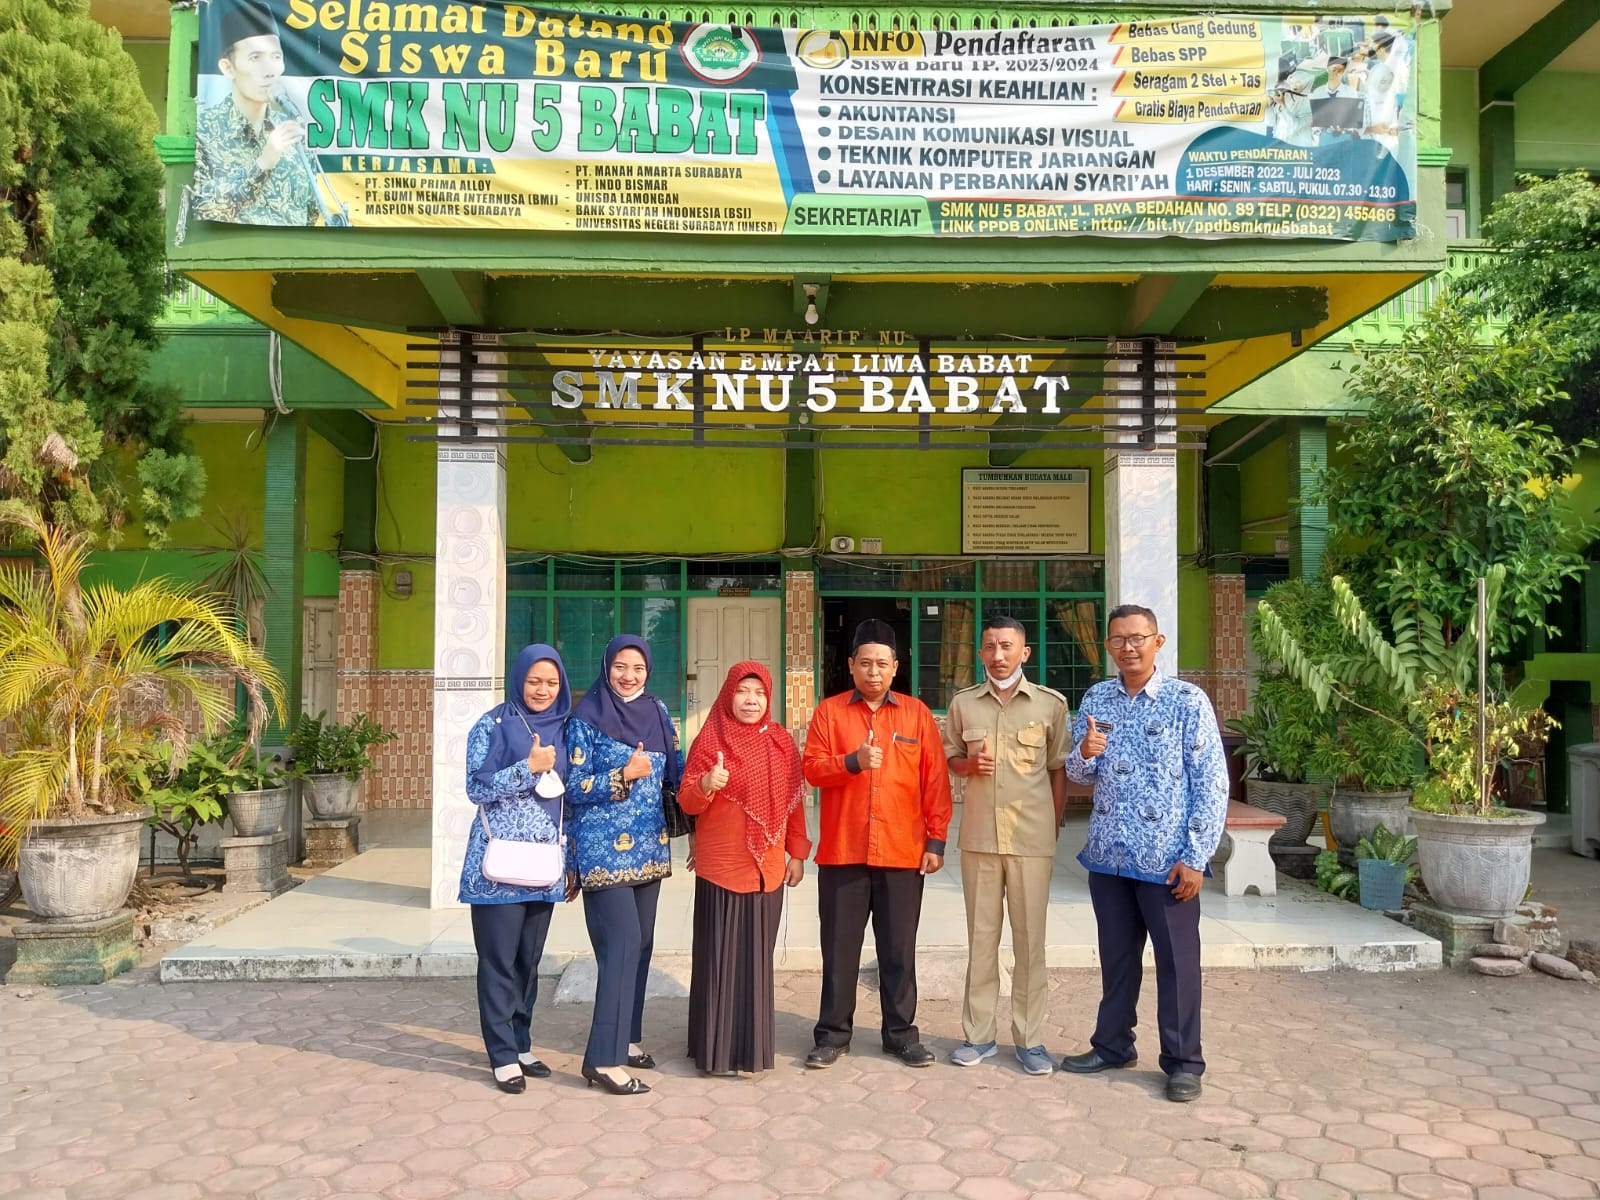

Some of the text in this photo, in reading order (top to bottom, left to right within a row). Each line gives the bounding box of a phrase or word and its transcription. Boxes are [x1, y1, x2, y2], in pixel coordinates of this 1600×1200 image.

[285, 0, 674, 50] Selamat Datang
[1128, 21, 1257, 39] Bebas Uang Gedung
[852, 30, 1096, 56] INFO Pendaftaran
[339, 31, 668, 83] Siswa Baru
[1131, 46, 1208, 63] Bebas SPP
[1007, 58, 1099, 72] 2023/2024
[820, 75, 972, 98] KONSENTRASI
[979, 79, 1086, 101] KEAHLIAN
[1133, 71, 1188, 91] Seragam
[1191, 74, 1199, 88] 2
[1201, 72, 1227, 87] Stel
[1240, 73, 1261, 89] Tas
[307, 79, 765, 155] SMK NU 5 BABAT
[838, 105, 956, 123] AKUNTANSI
[1135, 100, 1261, 121] Gratis Biaya Pendaftaran
[838, 125, 1134, 147] DESAIN KOMUNIKASI VISUAL
[838, 145, 1156, 169] TEKNIK KOMPUTER JARIANGAN
[1188, 151, 1227, 162] WAKTU
[1231, 149, 1308, 160] PENDAFTARAN
[576, 165, 743, 179] PT. MANAH AMARTA SURABAYA
[838, 169, 933, 190] LAYANAN
[940, 172, 1069, 191] PERBANKAN
[1186, 168, 1193, 179] 1
[1196, 166, 1254, 178] DESEMBER
[1258, 167, 1284, 178] 2022
[1293, 167, 1314, 179] JULI
[1315, 168, 1340, 181] 2023
[365, 177, 491, 191] PT. SINKO PRIMA ALLOY
[576, 179, 668, 190] PT. INDO BISMAR
[1186, 180, 1212, 192] HARI
[1220, 181, 1250, 193] SENIN
[1259, 181, 1296, 195] SABTU,
[1299, 182, 1331, 196] PUKUL
[1333, 184, 1362, 196] 07.30
[1369, 186, 1396, 198] 13.30
[365, 191, 558, 206] PT. BUMI MENARA INTERNUSA (BMI)
[576, 192, 679, 204] UNISDA LAMONGAN
[366, 204, 521, 217] MASPION SQUARE SURABAYA
[576, 205, 752, 219] BANK SYARI'AH INDONESIA (BSI)
[794, 207, 921, 227] SEKRETARIAT
[941, 202, 1396, 222] SMK NU 5 BABAT, JL. RAYA BEDAHAN NO. 89 TELP. (0322) 455466
[576, 218, 777, 233] UNIVERSITAS NEGERI SURABAYA (UNESA)
[941, 219, 975, 233] LINK
[979, 220, 1021, 233] PPDB
[1024, 218, 1078, 232] ONLINE
[1091, 217, 1334, 236] http://bit.ly/ppdbsmknu5babat
[725, 327, 750, 343] LP
[880, 330, 906, 346] NU
[588, 349, 1032, 373] YAYASAN EMPAT LIMA BABAT
[551, 371, 1071, 414] SMK NU 5 BABAT
[978, 473, 1023, 481] TUMBUHKAN
